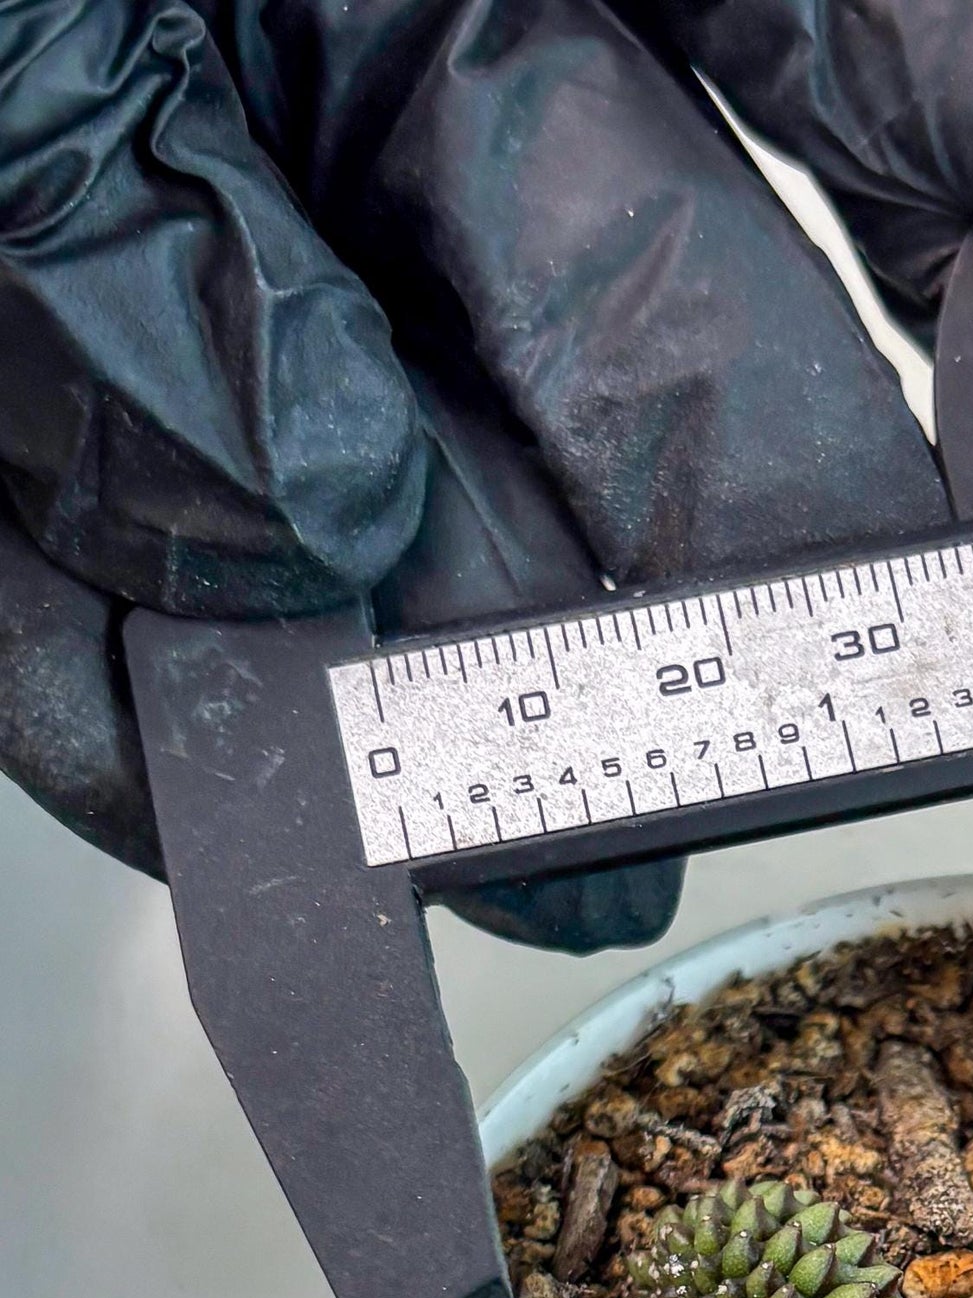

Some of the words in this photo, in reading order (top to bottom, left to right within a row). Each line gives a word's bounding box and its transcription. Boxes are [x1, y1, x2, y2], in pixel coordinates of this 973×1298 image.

[369, 747, 400, 778] 0
[498, 691, 550, 726] 10
[656, 657, 725, 696] 20
[832, 623, 899, 662] 30
[433, 792, 443, 809] 1
[469, 784, 489, 804] 2
[513, 775, 534, 794] 3
[559, 767, 578, 785] 4
[602, 758, 622, 777] 5
[647, 750, 667, 769] 6
[694, 741, 711, 760] 7
[734, 732, 756, 752] 8
[778, 723, 799, 744] 9
[818, 693, 836, 721] 1
[876, 706, 886, 724] 1
[910, 698, 931, 718] 2
[953, 689, 973, 708] 3
